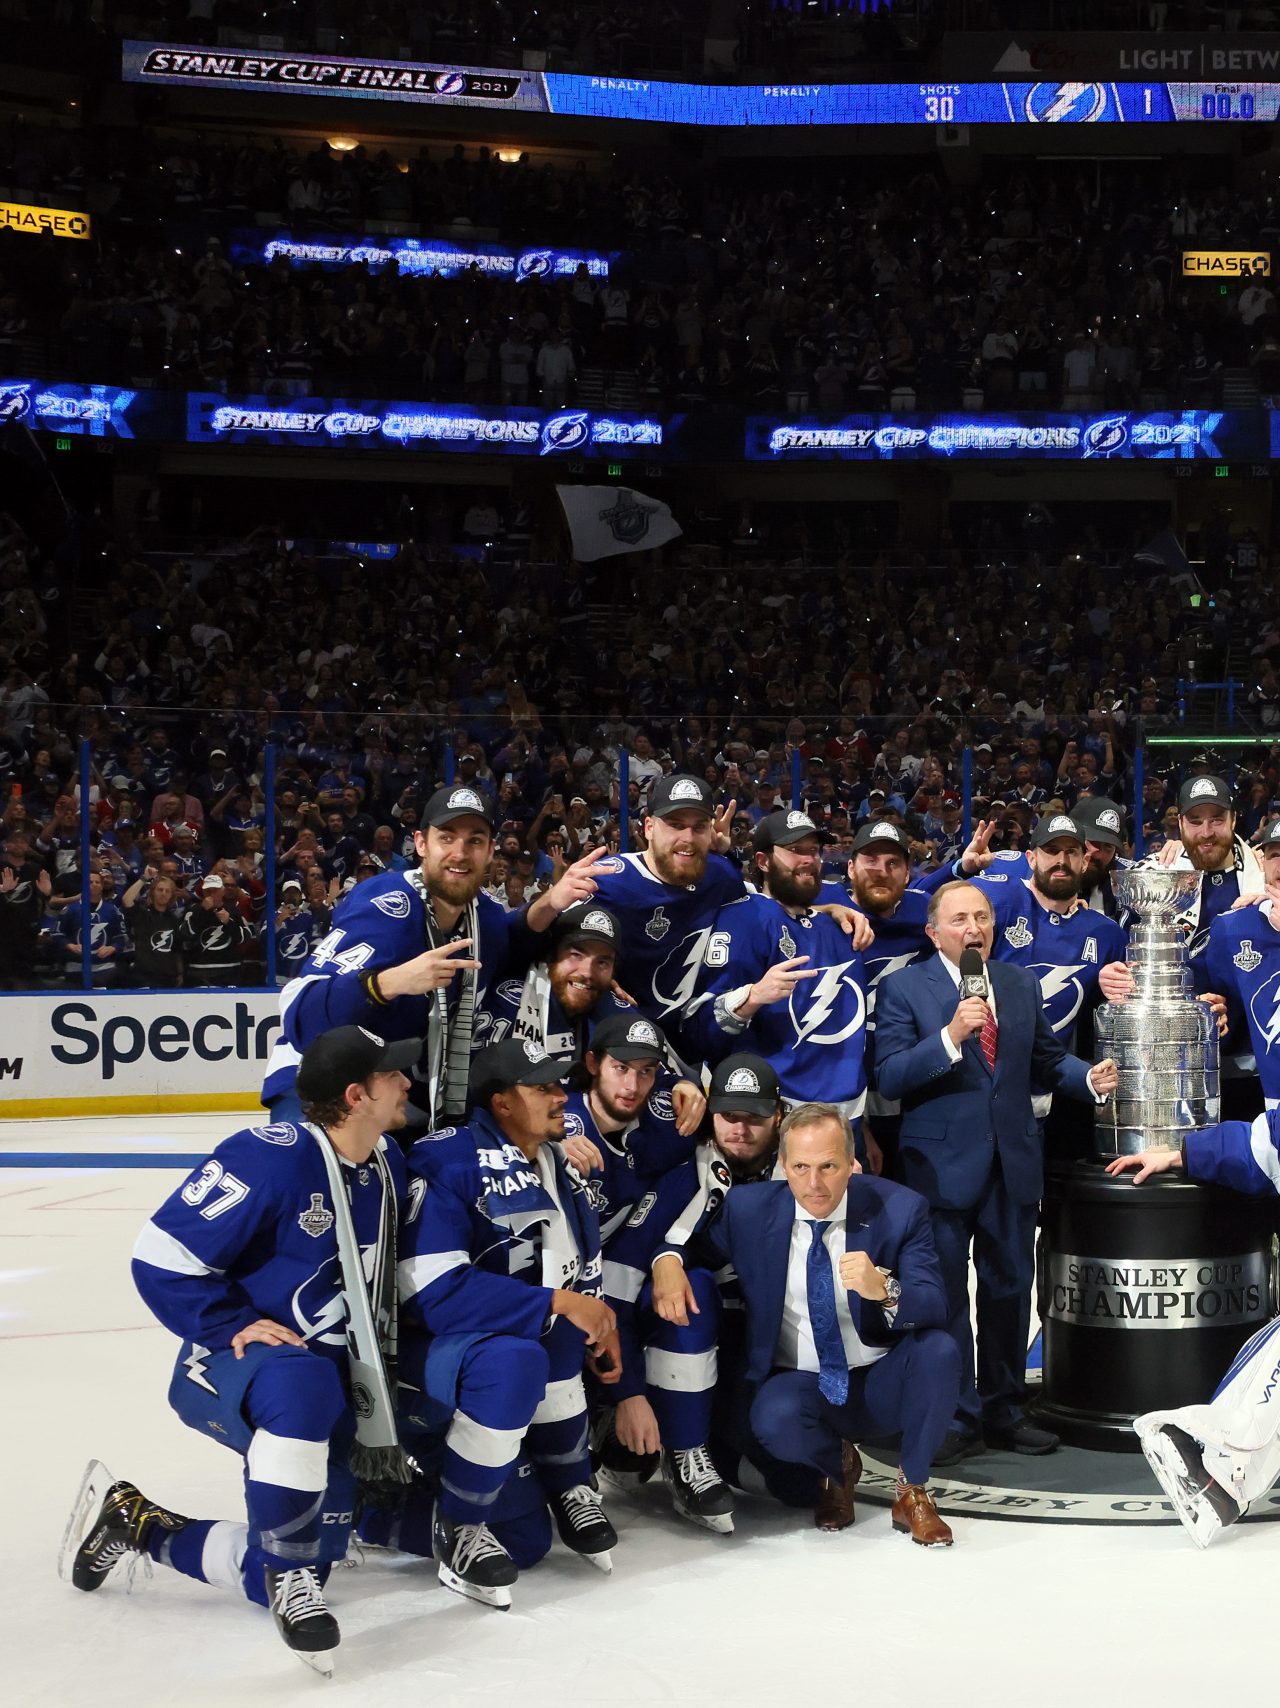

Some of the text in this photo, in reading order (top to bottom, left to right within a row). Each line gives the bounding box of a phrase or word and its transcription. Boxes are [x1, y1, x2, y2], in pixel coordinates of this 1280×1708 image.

[1119, 49, 1193, 70] LIGHT
[151, 53, 509, 93] STANLEY CUP FINAL 2021
[590, 78, 650, 93] PENALTY
[763, 86, 821, 98] PENALTY
[919, 84, 962, 96] SHOTS
[1214, 83, 1242, 94] Final
[925, 96, 954, 121] 30
[1143, 88, 1152, 116] 1
[1183, 257, 1249, 271] CHASE
[35, 393, 112, 421] 2021
[213, 405, 663, 445] STANLEY CUP CHAMPIONS 2021
[769, 421, 1200, 452] STANLEY CUP CHAMPIONS 2021
[647, 921, 670, 930] FINAL
[311, 927, 377, 977] 44
[703, 931, 733, 968] 6
[1082, 935, 1099, 964] A
[1234, 953, 1263, 963] FINAL
[50, 1002, 281, 1080] Spectr
[181, 1159, 251, 1221] 37
[301, 1214, 333, 1224] FINAL
[1068, 1263, 1244, 1288] STANLEY CUP
[1052, 1283, 1261, 1320] CHAMPIONS
